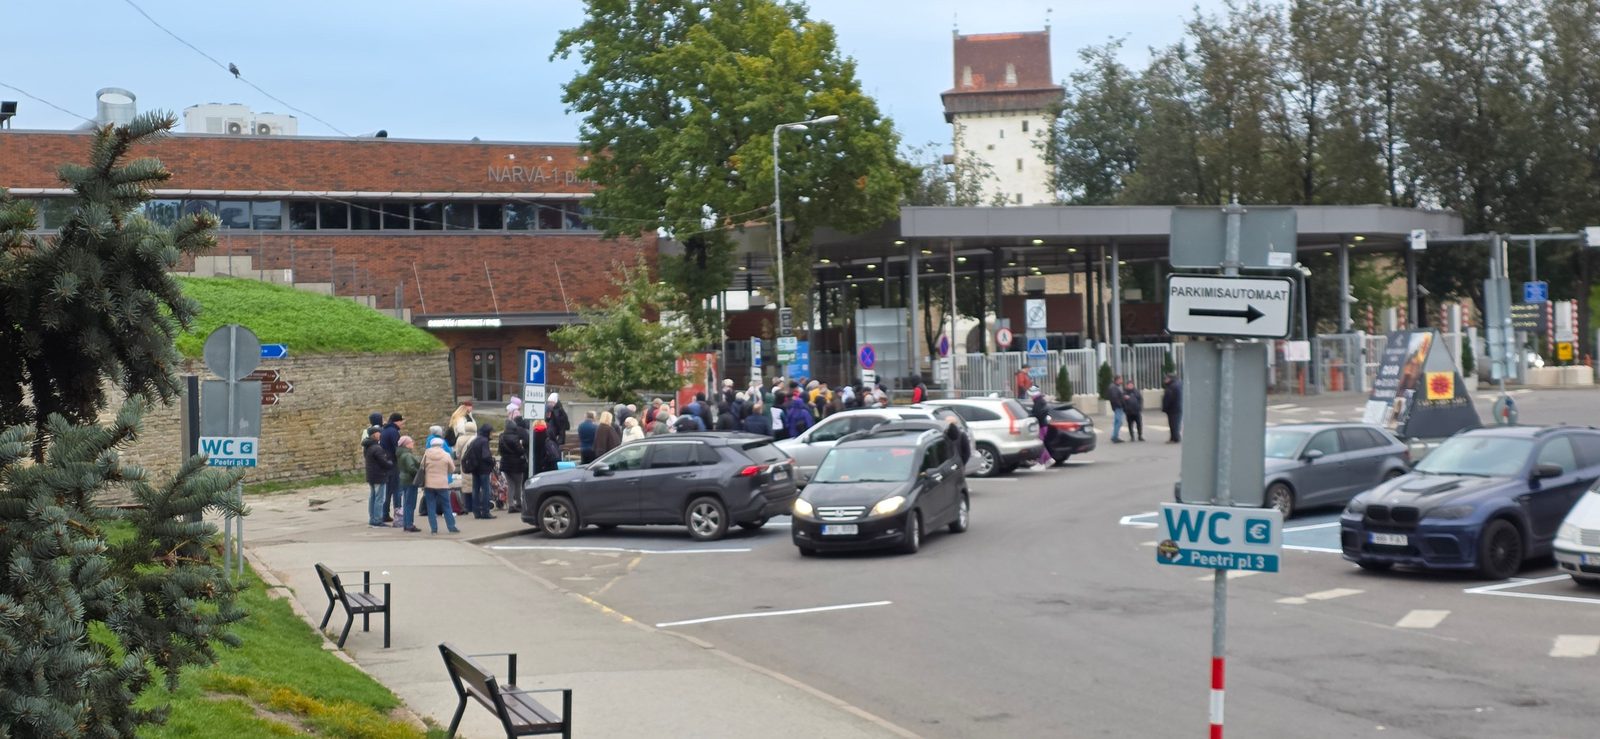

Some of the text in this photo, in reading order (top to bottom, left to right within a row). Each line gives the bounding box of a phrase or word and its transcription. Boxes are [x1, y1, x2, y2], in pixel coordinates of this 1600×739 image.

[488, 165, 559, 182] NARVA-1
[1170, 286, 1289, 301] PARKIMISAUTOMAAT
[529, 354, 542, 382] P
[201, 439, 235, 456] WC
[1164, 507, 1233, 546] WC
[1190, 551, 1265, 570] Peetri pl 3
